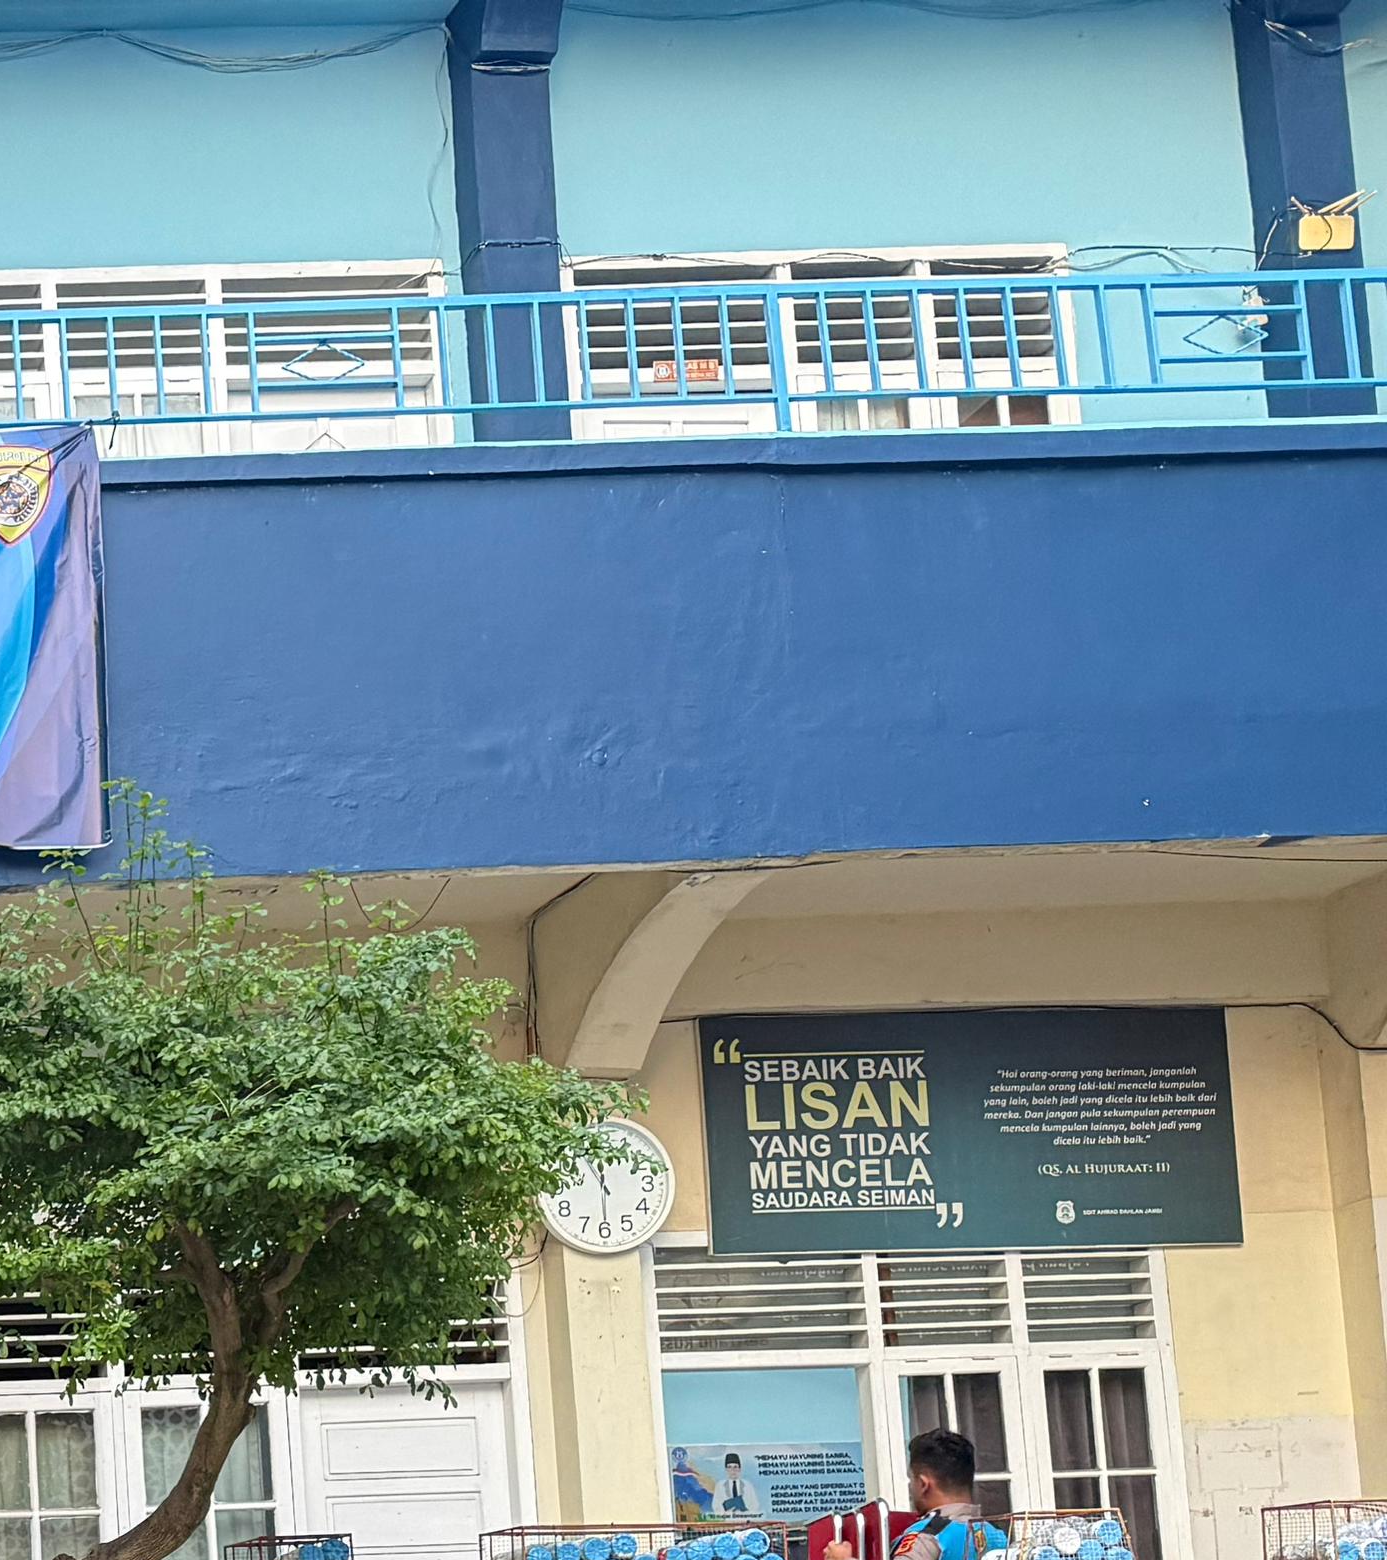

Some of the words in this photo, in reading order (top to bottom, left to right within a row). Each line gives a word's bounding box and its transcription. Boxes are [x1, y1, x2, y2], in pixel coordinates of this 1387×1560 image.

[744, 1058, 849, 1082] SEBAIK
[857, 1056, 926, 1080] BAIK
[1020, 1070, 1077, 1081] orang-orang
[1080, 1069, 1103, 1079] yang
[1149, 1067, 1197, 1077] janganlah
[990, 1082, 1046, 1093] sekumpulan
[1049, 1084, 1076, 1092] orang
[1078, 1081, 1115, 1090] laki-laki
[1118, 1081, 1157, 1090] mencela
[1159, 1080, 1205, 1091] kumpulan
[745, 1080, 930, 1130] LISAN
[984, 1098, 1006, 1108] yang
[1032, 1096, 1057, 1105] boleh
[1060, 1095, 1078, 1106] jadi
[1080, 1096, 1103, 1106] yang
[1106, 1094, 1132, 1103] dicela
[1135, 1094, 1148, 1103] itu
[1150, 1093, 1173, 1102] lebih
[1176, 1093, 1195, 1102] baik
[1198, 1092, 1216, 1101] dari
[984, 1110, 1022, 1119] mereka.
[1025, 1110, 1043, 1119] Dan
[1045, 1110, 1078, 1120] jangan
[1080, 1109, 1100, 1119] pula
[1103, 1108, 1159, 1119] sekumpulan
[1162, 1109, 1216, 1118] perempuan
[1000, 1123, 1039, 1132] mencela
[1042, 1122, 1088, 1133] kumpulan
[1130, 1121, 1156, 1130] boleh
[1158, 1120, 1176, 1131] jadi
[1178, 1121, 1201, 1131] yang
[749, 1134, 831, 1158] YANG
[839, 1132, 931, 1156] TIDAK
[1053, 1136, 1080, 1145] dicela
[1083, 1135, 1095, 1145] itu
[1098, 1135, 1121, 1144] lebih
[749, 1158, 933, 1189] MENCELA
[641, 1175, 654, 1192] 3
[635, 1198, 649, 1214] 4
[752, 1191, 852, 1209] SAUDARA
[857, 1189, 935, 1206] SEIMAN
[558, 1200, 571, 1217] 8
[579, 1216, 590, 1233] 7
[598, 1222, 611, 1238] 6
[620, 1214, 633, 1232] 5
